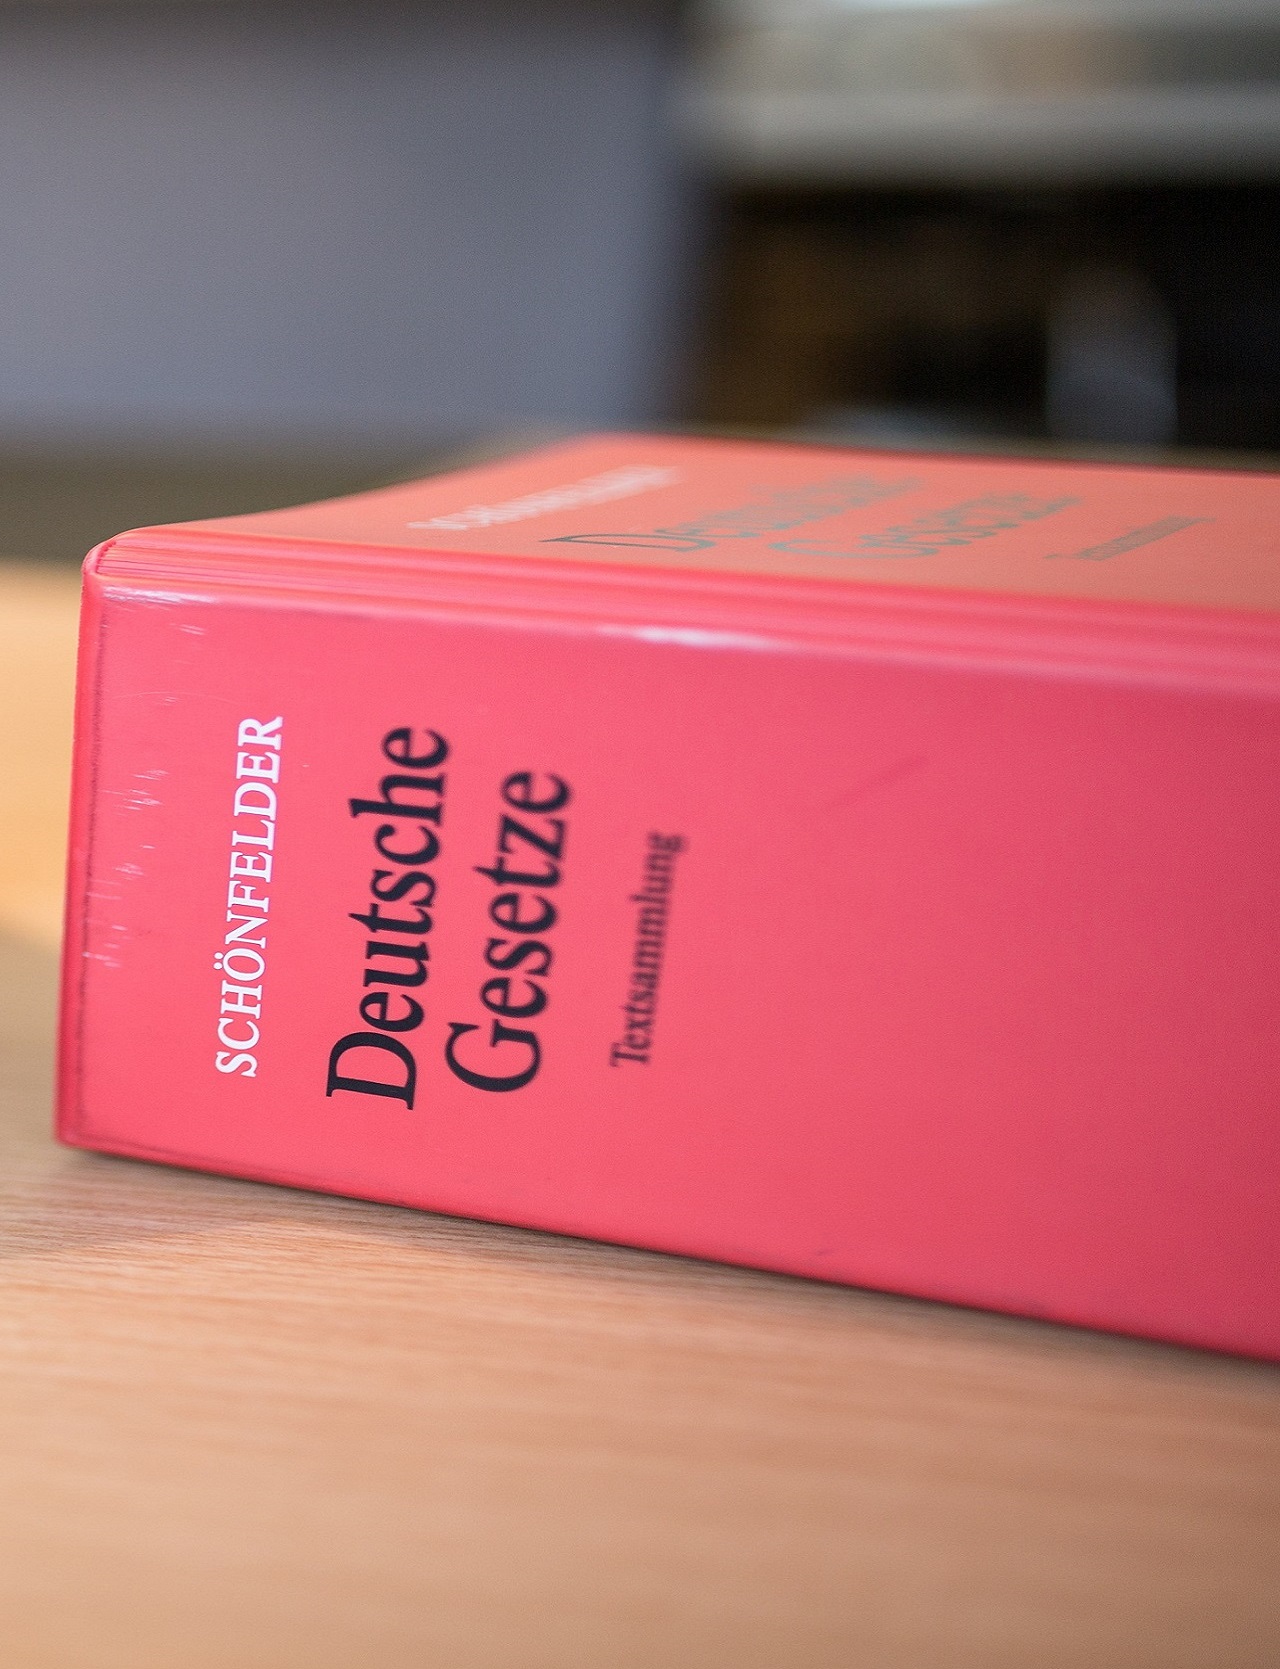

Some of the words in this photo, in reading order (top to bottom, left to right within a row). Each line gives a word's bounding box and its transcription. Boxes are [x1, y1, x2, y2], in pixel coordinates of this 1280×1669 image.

[213, 715, 284, 1078] SCHÖNFELDER
[326, 727, 450, 1111] Deutsche
[444, 770, 572, 1093] Gesetze
[610, 831, 689, 1068] Textsammlung
